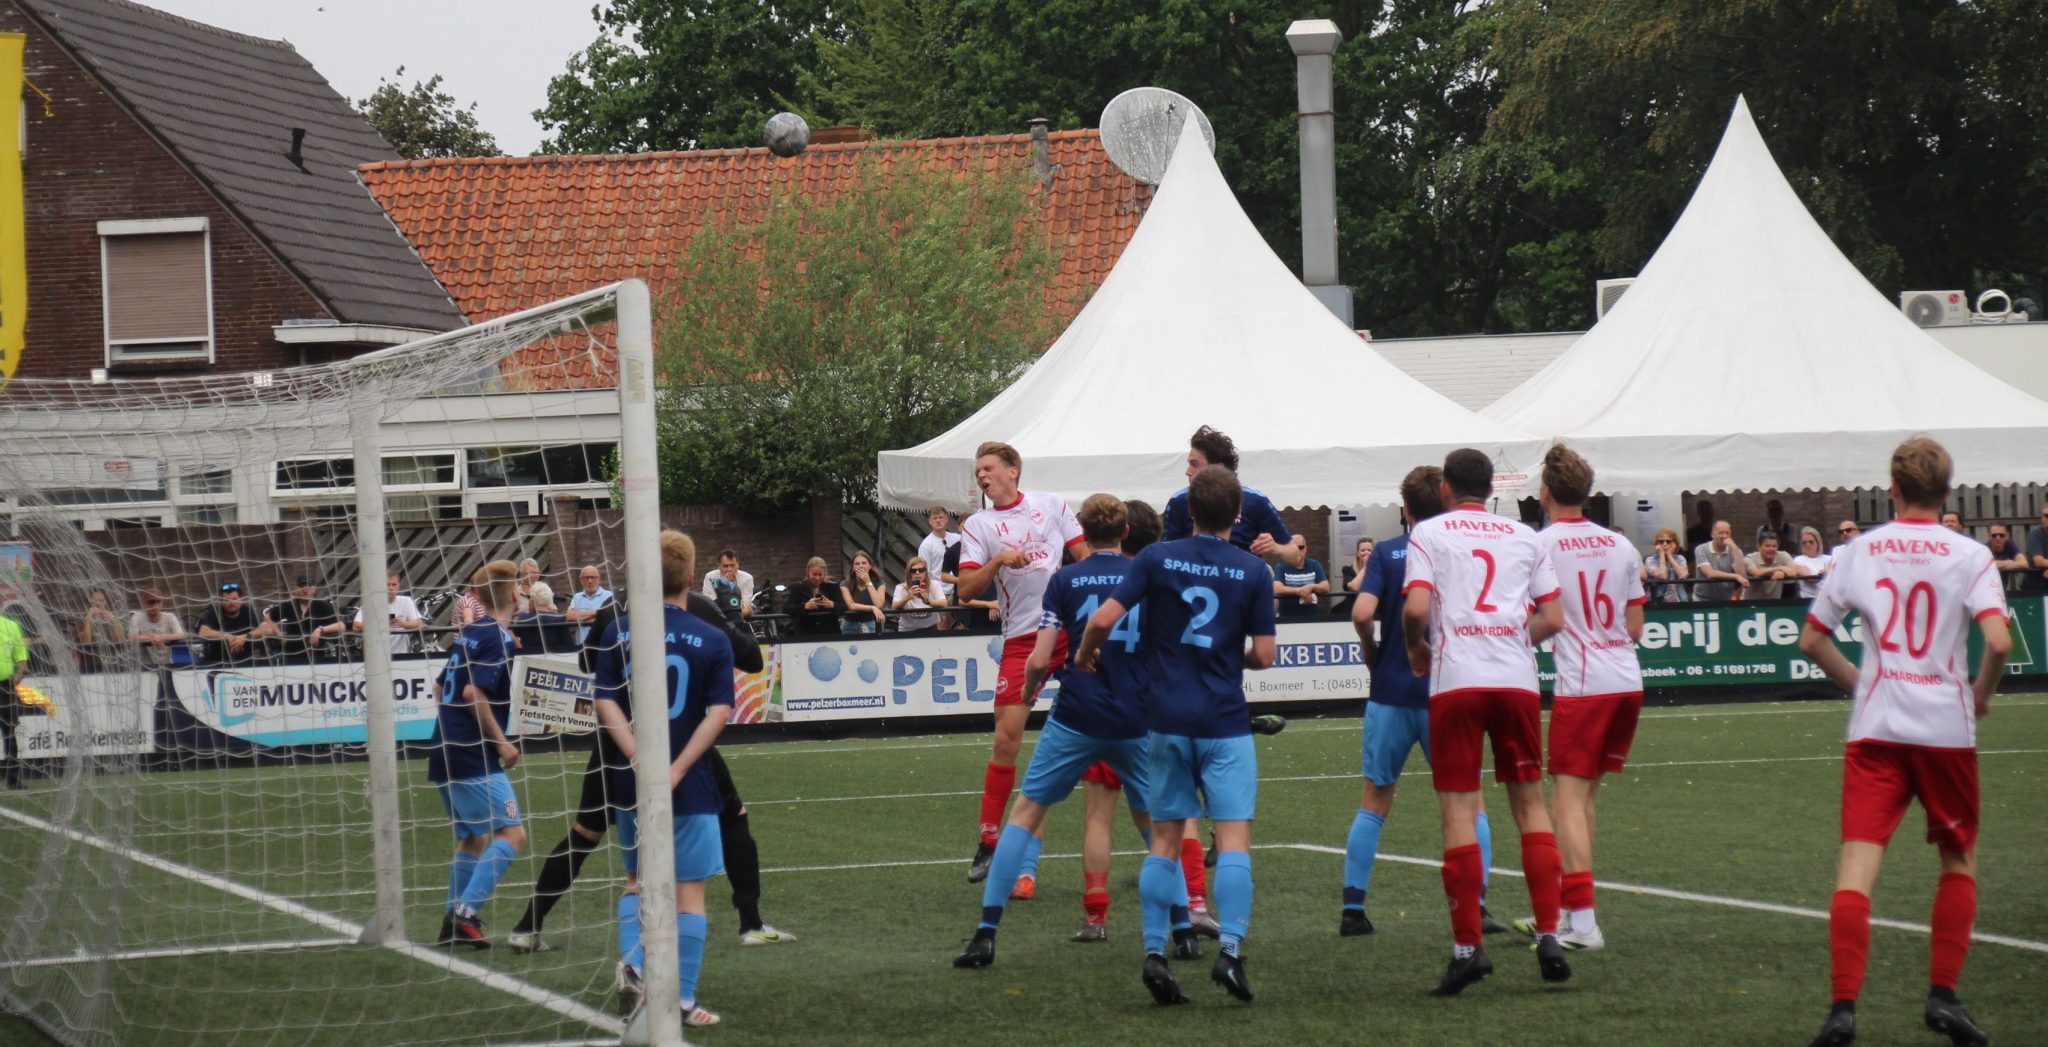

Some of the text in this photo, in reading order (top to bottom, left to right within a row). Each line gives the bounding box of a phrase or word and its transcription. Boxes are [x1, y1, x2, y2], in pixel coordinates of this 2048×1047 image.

[994, 521, 1009, 537] 14
[1444, 520, 1515, 534] HAVENS
[1558, 536, 1616, 551] HAVENS
[1869, 539, 1952, 557] HAVENS
[1028, 550, 1048, 561] ENS
[1164, 558, 1219, 577] SPARTA
[1071, 575, 1124, 588] SPARTA
[1472, 548, 1498, 612] 2
[1578, 569, 1615, 631] 16
[1181, 586, 1219, 648] 2
[1875, 577, 1937, 660] 20
[1454, 625, 1518, 636] VOLHARDING
[1738, 612, 1799, 646] de
[1273, 644, 1362, 665] KBEDR
[1686, 666, 1703, 676] 06
[1713, 664, 1776, 675] 51691768
[527, 671, 560, 692] PEEL
[563, 679, 582, 694] EN
[1260, 680, 1304, 692] Boxmeer
[1327, 678, 1362, 692] (0485)
[232, 686, 258, 696] VAN
[259, 678, 433, 707] MUNCKOF.
[233, 698, 258, 708] DEN
[787, 696, 886, 711] www.pelzerboxmeer.nl
[323, 705, 357, 719] print
[519, 708, 567, 724] Fietstocht
